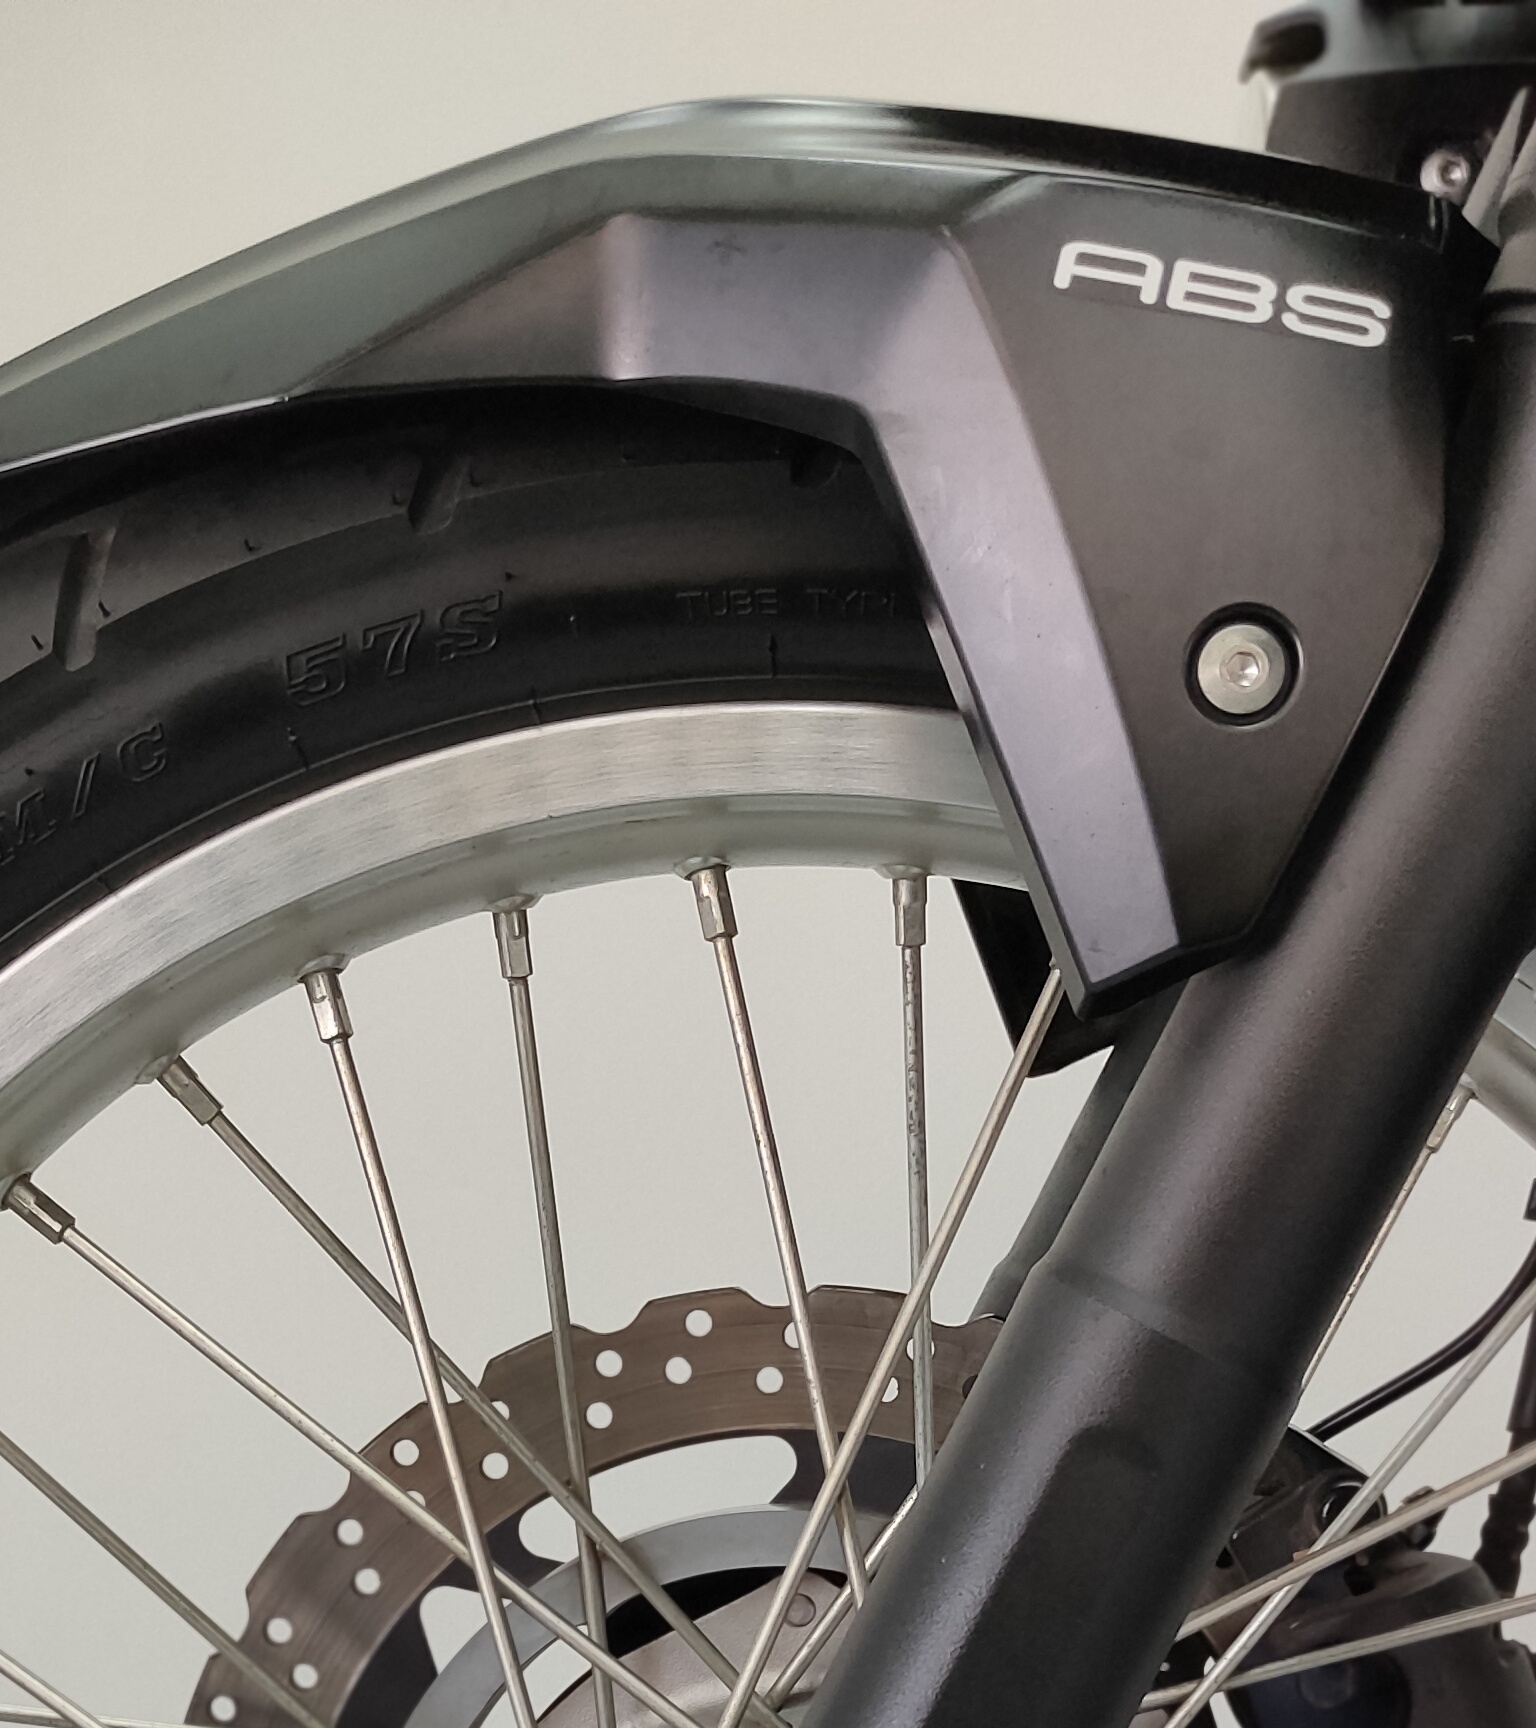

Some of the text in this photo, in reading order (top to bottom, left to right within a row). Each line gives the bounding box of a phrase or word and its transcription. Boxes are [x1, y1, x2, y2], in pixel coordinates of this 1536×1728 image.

[1053, 240, 1392, 348] ABS
[286, 589, 503, 705] 57S
[675, 586, 778, 619] TUBE
